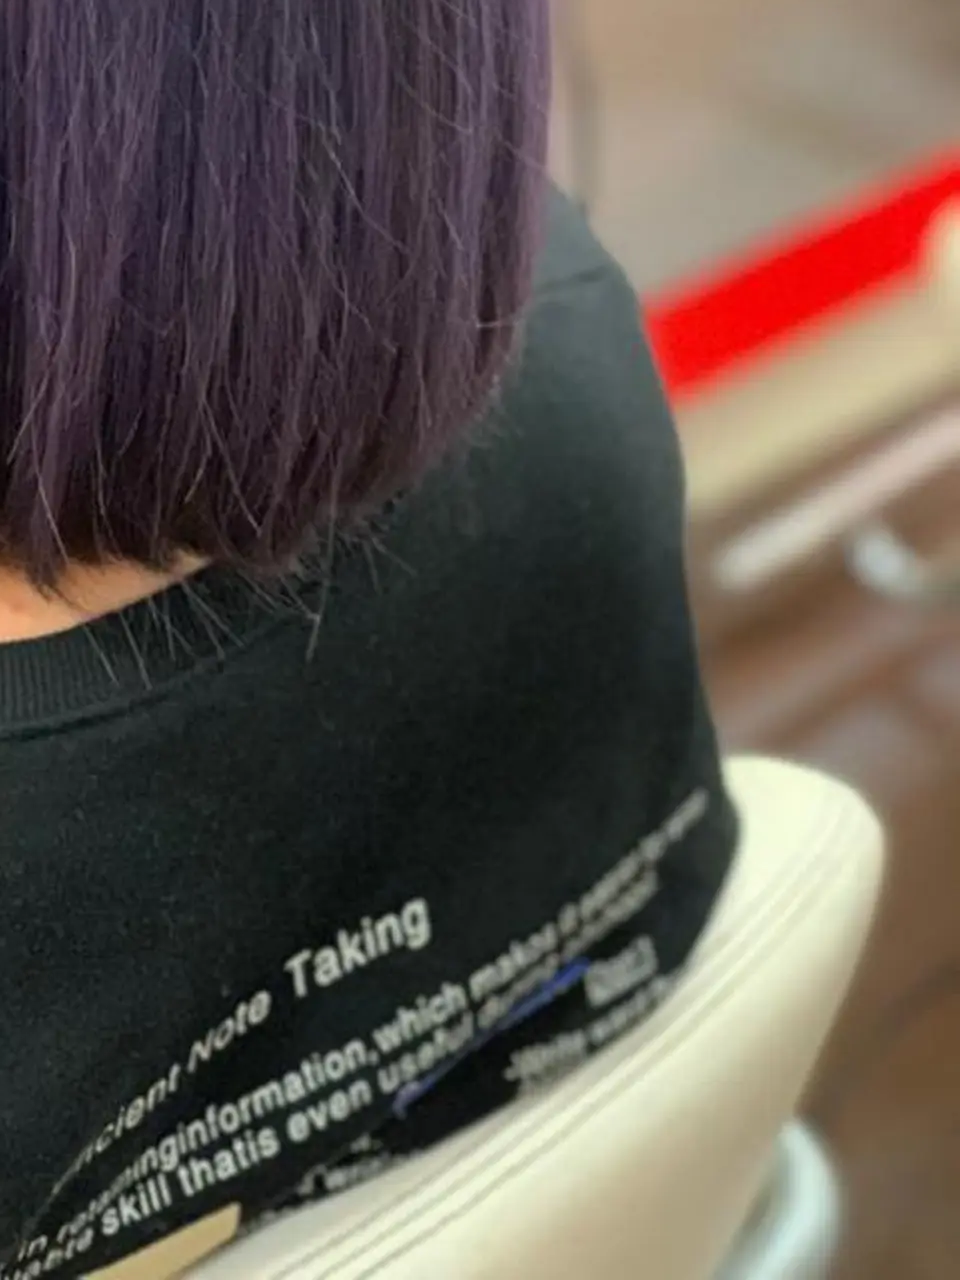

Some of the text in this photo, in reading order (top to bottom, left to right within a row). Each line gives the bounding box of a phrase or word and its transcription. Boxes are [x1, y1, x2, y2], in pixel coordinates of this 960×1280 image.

[187, 989, 272, 1073] Note
[283, 897, 431, 998] Taking
[101, 1173, 172, 1236] skill
[286, 1080, 373, 1143] even
